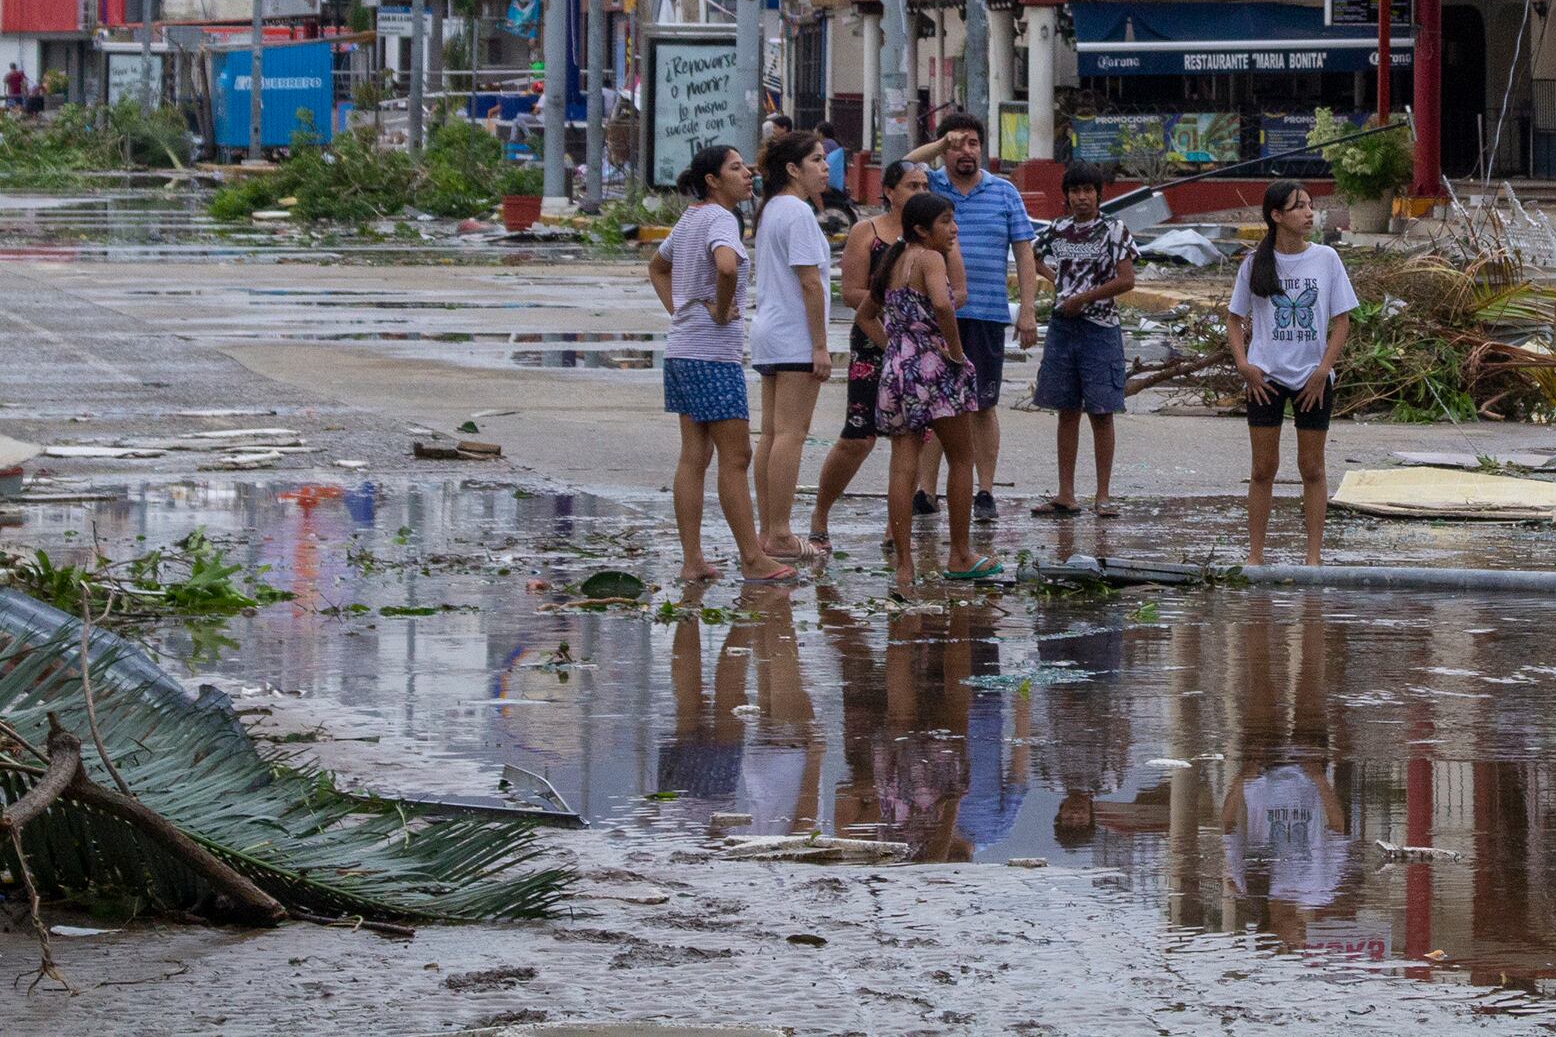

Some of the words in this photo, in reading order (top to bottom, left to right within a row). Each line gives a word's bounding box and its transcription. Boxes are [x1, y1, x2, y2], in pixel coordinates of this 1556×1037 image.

[1184, 54, 1249, 70] RESTAURANTE
[1289, 52, 1327, 69] BONITA"
[694, 101, 728, 118] mismo
[705, 117, 724, 132] con
